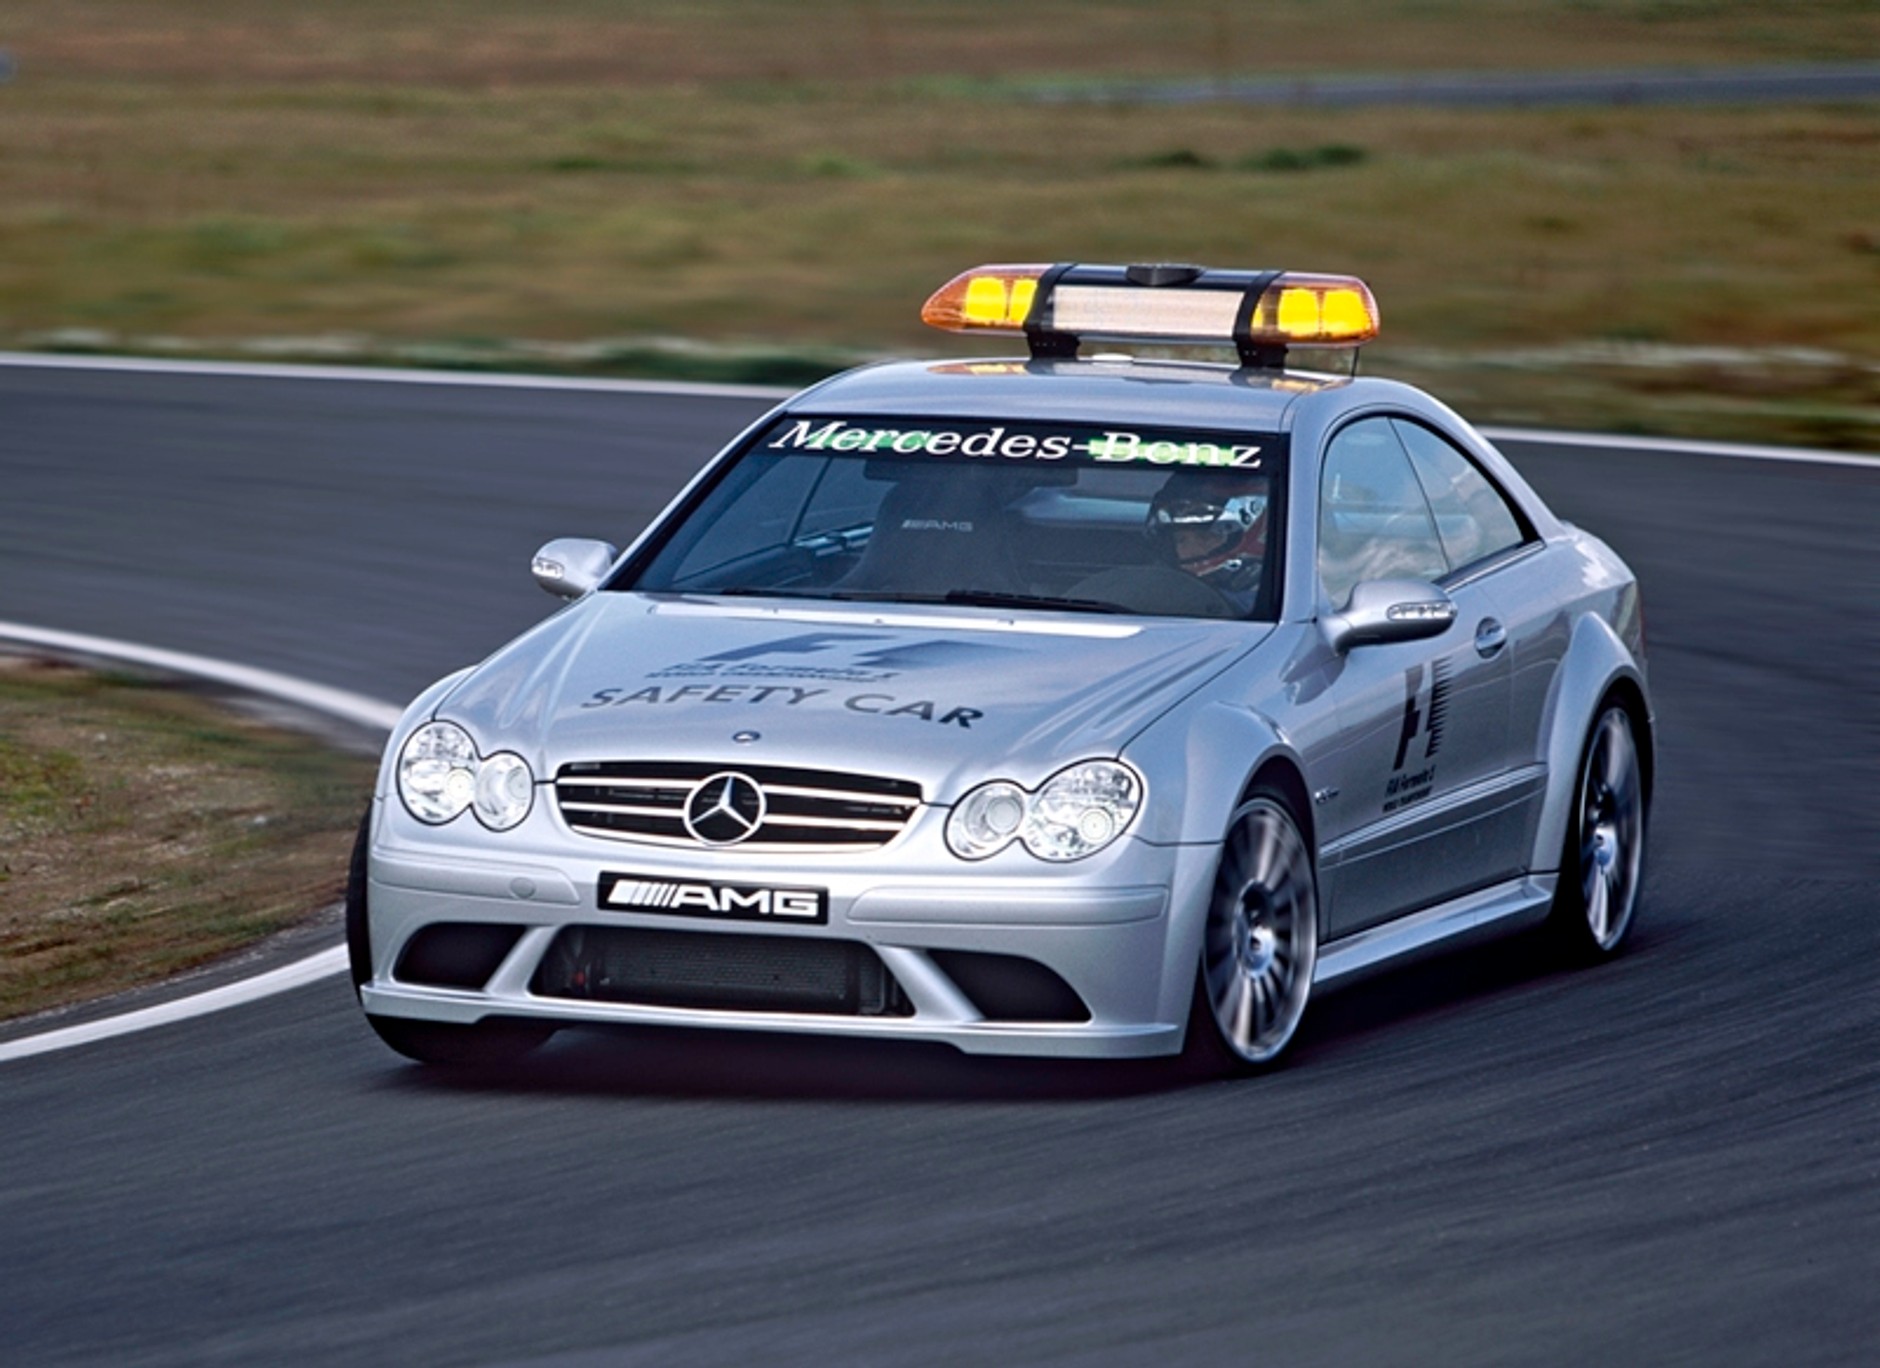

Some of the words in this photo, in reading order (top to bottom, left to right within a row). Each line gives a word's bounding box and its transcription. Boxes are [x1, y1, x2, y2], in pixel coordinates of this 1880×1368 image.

[768, 420, 1262, 470] Mercedes-Benz
[924, 519, 973, 533] AMG
[580, 683, 829, 709] SAFETY
[844, 693, 984, 729] CAR
[670, 882, 820, 918] AMG
